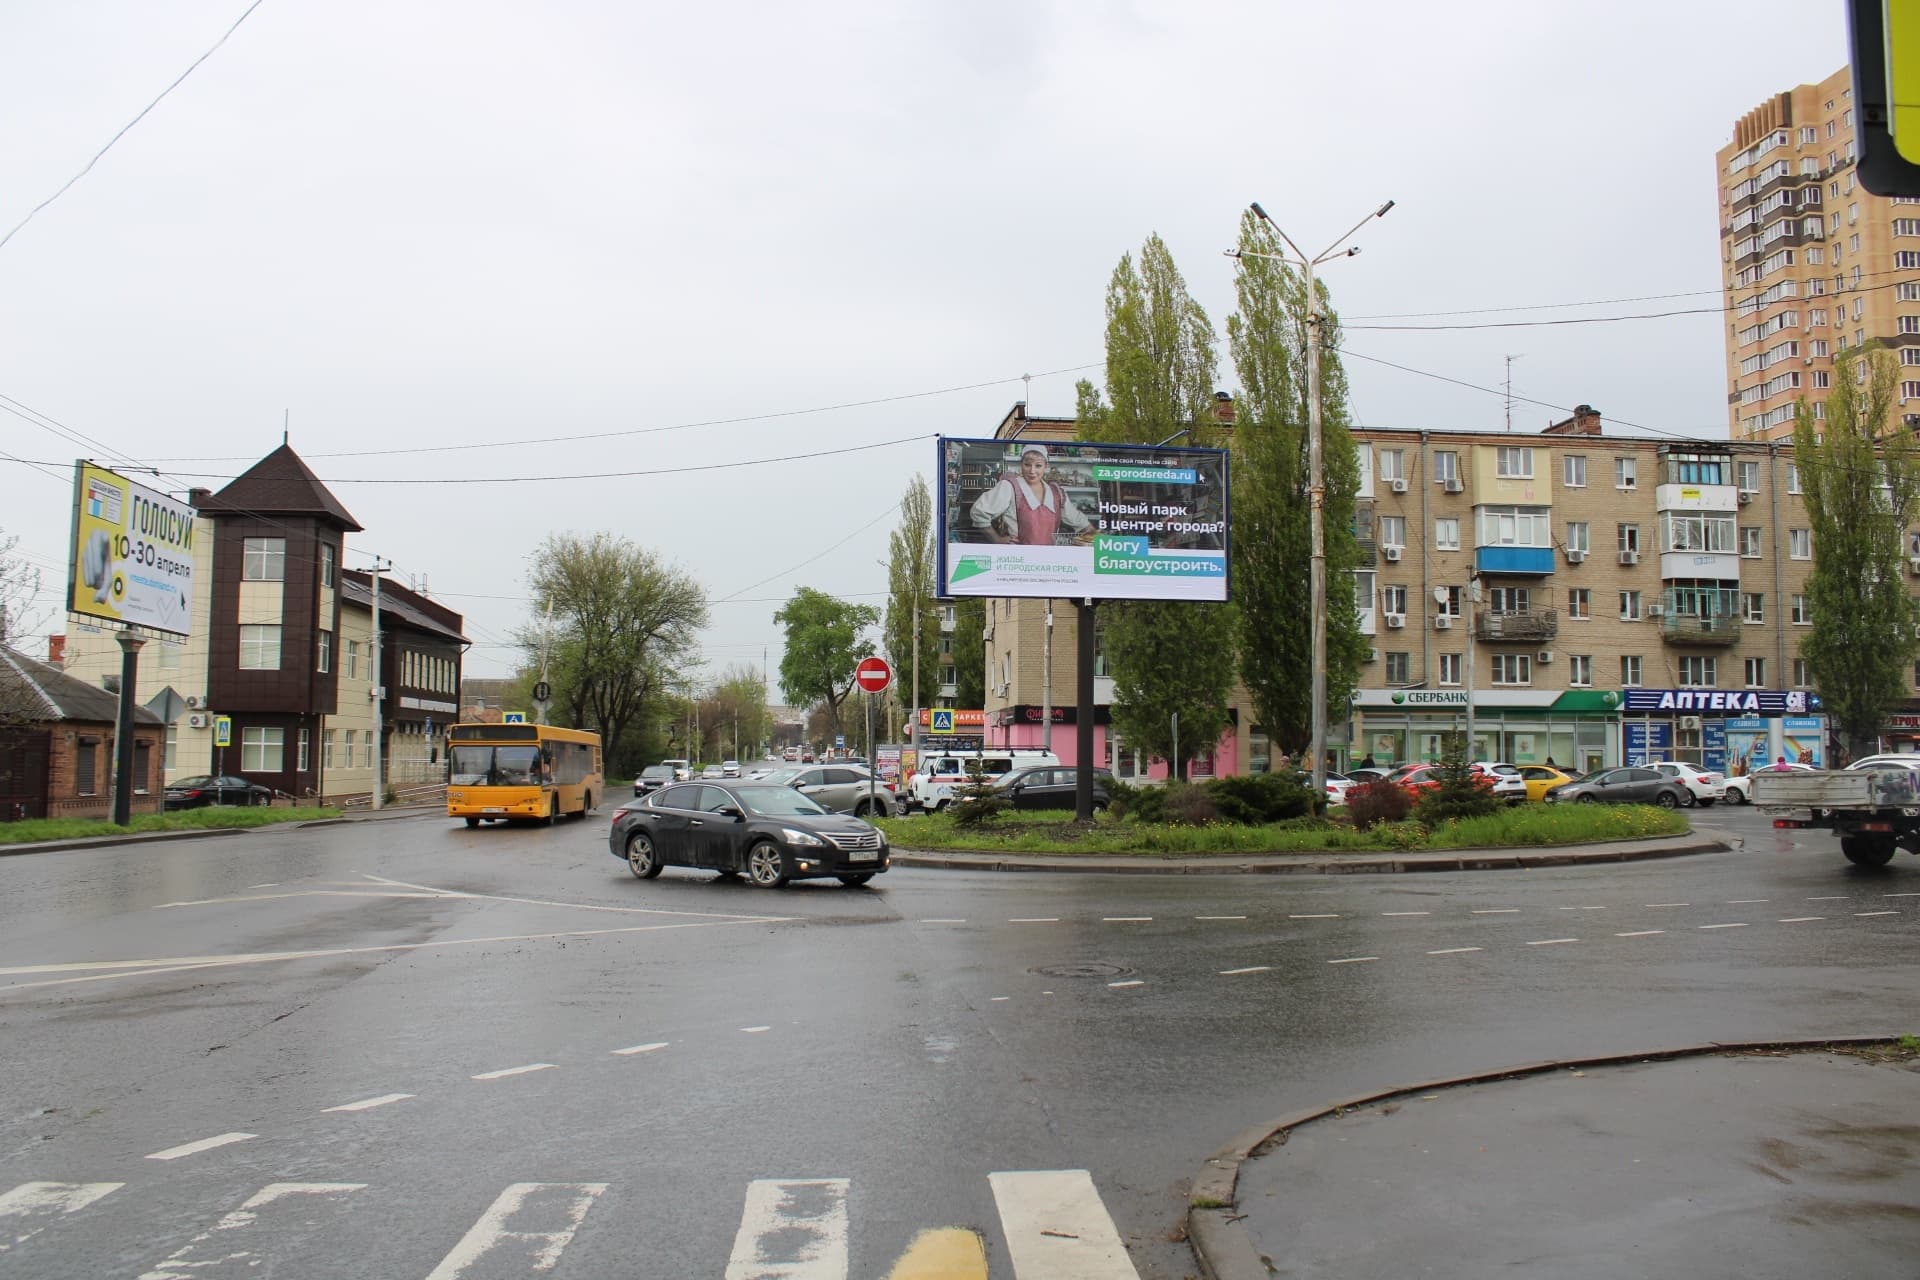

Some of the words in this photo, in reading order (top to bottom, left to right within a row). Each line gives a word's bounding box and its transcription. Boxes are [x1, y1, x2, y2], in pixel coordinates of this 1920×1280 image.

[1098, 468, 1192, 480] za.gorodsreda.ru
[1099, 501, 1148, 515] Новый
[1152, 504, 1187, 518] парк
[132, 495, 193, 550] ГОЛОСУЙ
[1099, 520, 1107, 529] в
[1111, 520, 1163, 533] центре
[1167, 521, 1224, 534] города?
[1099, 538, 1140, 555] Могу
[114, 533, 155, 567] 10-30
[157, 556, 190, 578] апреля
[1004, 564, 1051, 573] ГОРОДСКАЯ
[1053, 565, 1078, 574] СРЕДА
[1099, 556, 1222, 573] благоустроить.
[1408, 692, 1468, 703] СБЕРБАНК
[1659, 692, 1759, 710] АПТЕКА
